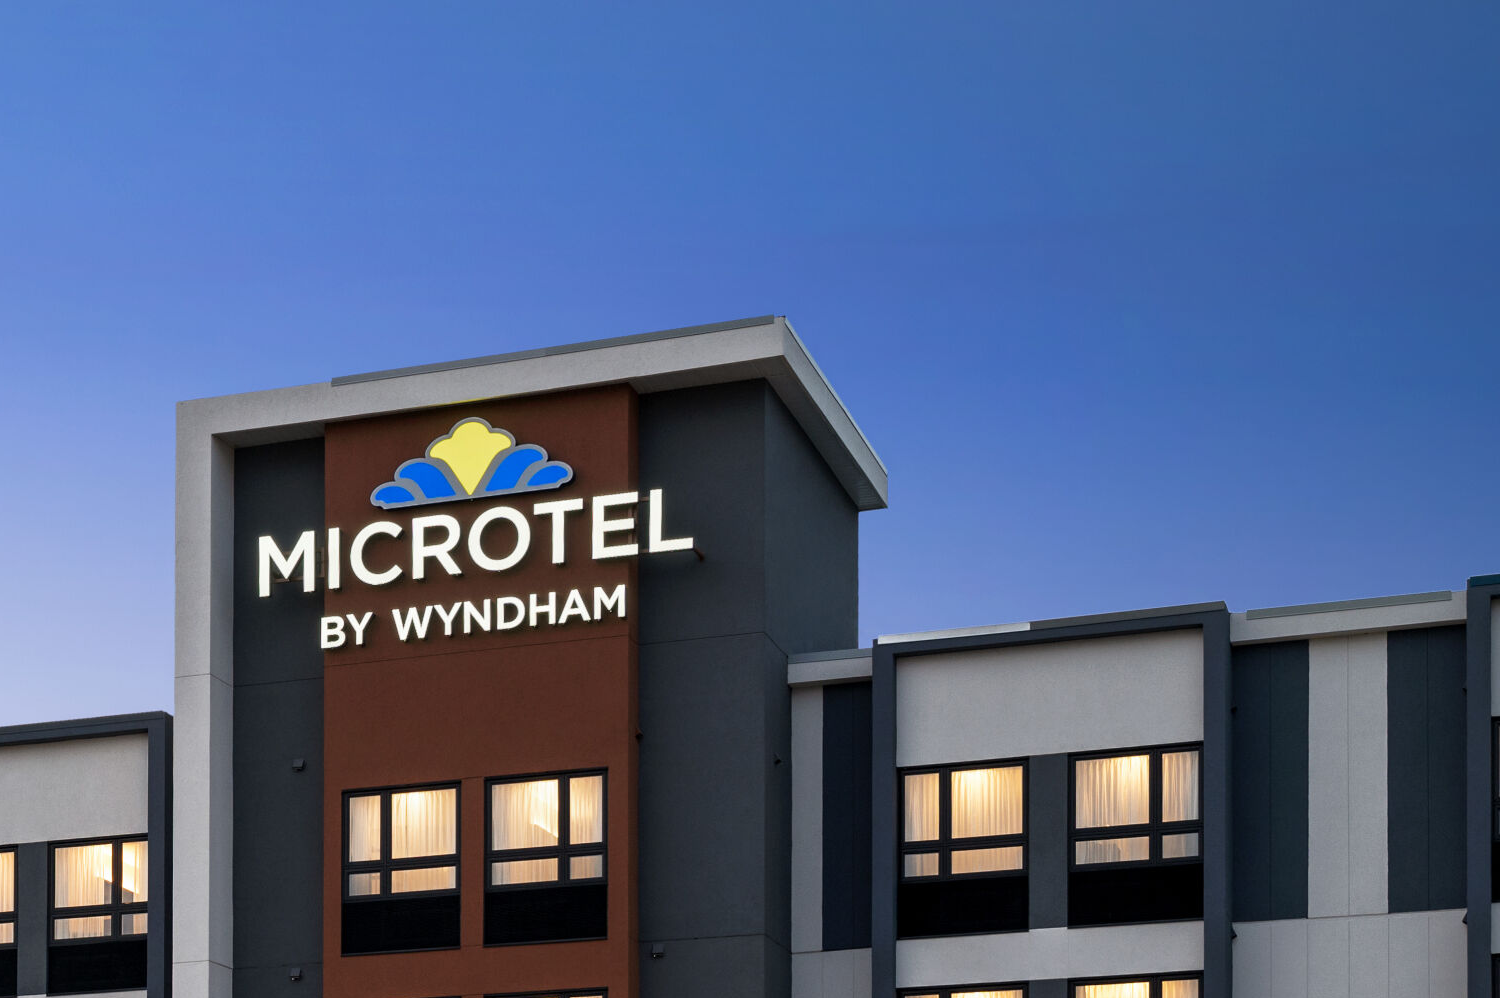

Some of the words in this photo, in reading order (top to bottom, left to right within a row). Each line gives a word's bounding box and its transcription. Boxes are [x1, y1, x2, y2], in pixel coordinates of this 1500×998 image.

[258, 488, 694, 598] MICROTEL
[320, 611, 373, 649] BY
[391, 583, 626, 641] WYNDHAM
